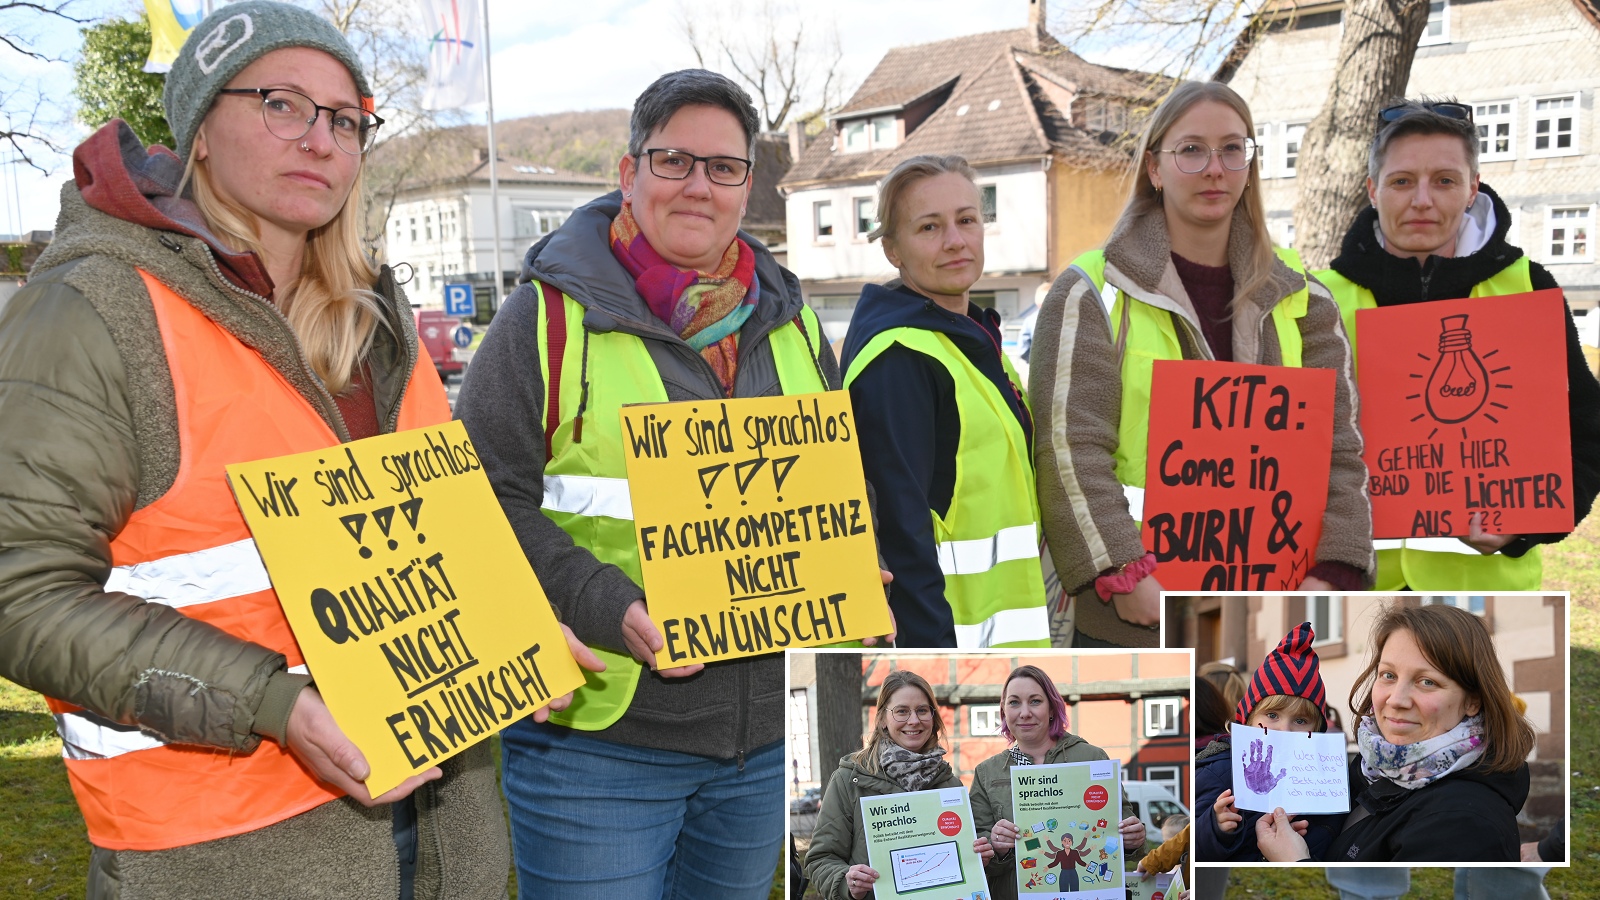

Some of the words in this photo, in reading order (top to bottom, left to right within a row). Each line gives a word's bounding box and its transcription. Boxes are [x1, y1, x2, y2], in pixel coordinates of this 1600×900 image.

[449, 287, 467, 312] P
[624, 413, 672, 459] Wir
[685, 402, 734, 456] sind
[743, 398, 851, 459] sprachlos
[1159, 439, 1235, 489] Come
[1250, 444, 1279, 491] in
[1378, 443, 1444, 472] GEHEN
[1460, 438, 1510, 469] HIER
[240, 471, 300, 518] Wir
[314, 448, 375, 507] sind
[381, 431, 482, 499] sprachlos
[1369, 474, 1410, 497] BALD
[1425, 470, 1454, 496] DIE
[640, 499, 867, 561] FACHKOMPETENZ
[1147, 506, 1255, 564] BURN
[1267, 490, 1302, 554] &
[1411, 510, 1452, 536] AUS
[663, 593, 847, 662] ERWÜNSCHT
[379, 608, 476, 692] NICHT
[385, 643, 552, 770] ERWÜNSCHT
[1291, 764, 1318, 772] mich
[1321, 764, 1337, 772] ins
[1293, 749, 1315, 761] Wer
[1017, 776, 1036, 786] Wir
[1038, 774, 1058, 785] sind
[1019, 787, 1063, 800] sprachlos
[1287, 788, 1303, 796] ich
[869, 806, 887, 816] Wir
[890, 803, 910, 814] sind
[872, 815, 917, 831] sprachlos
